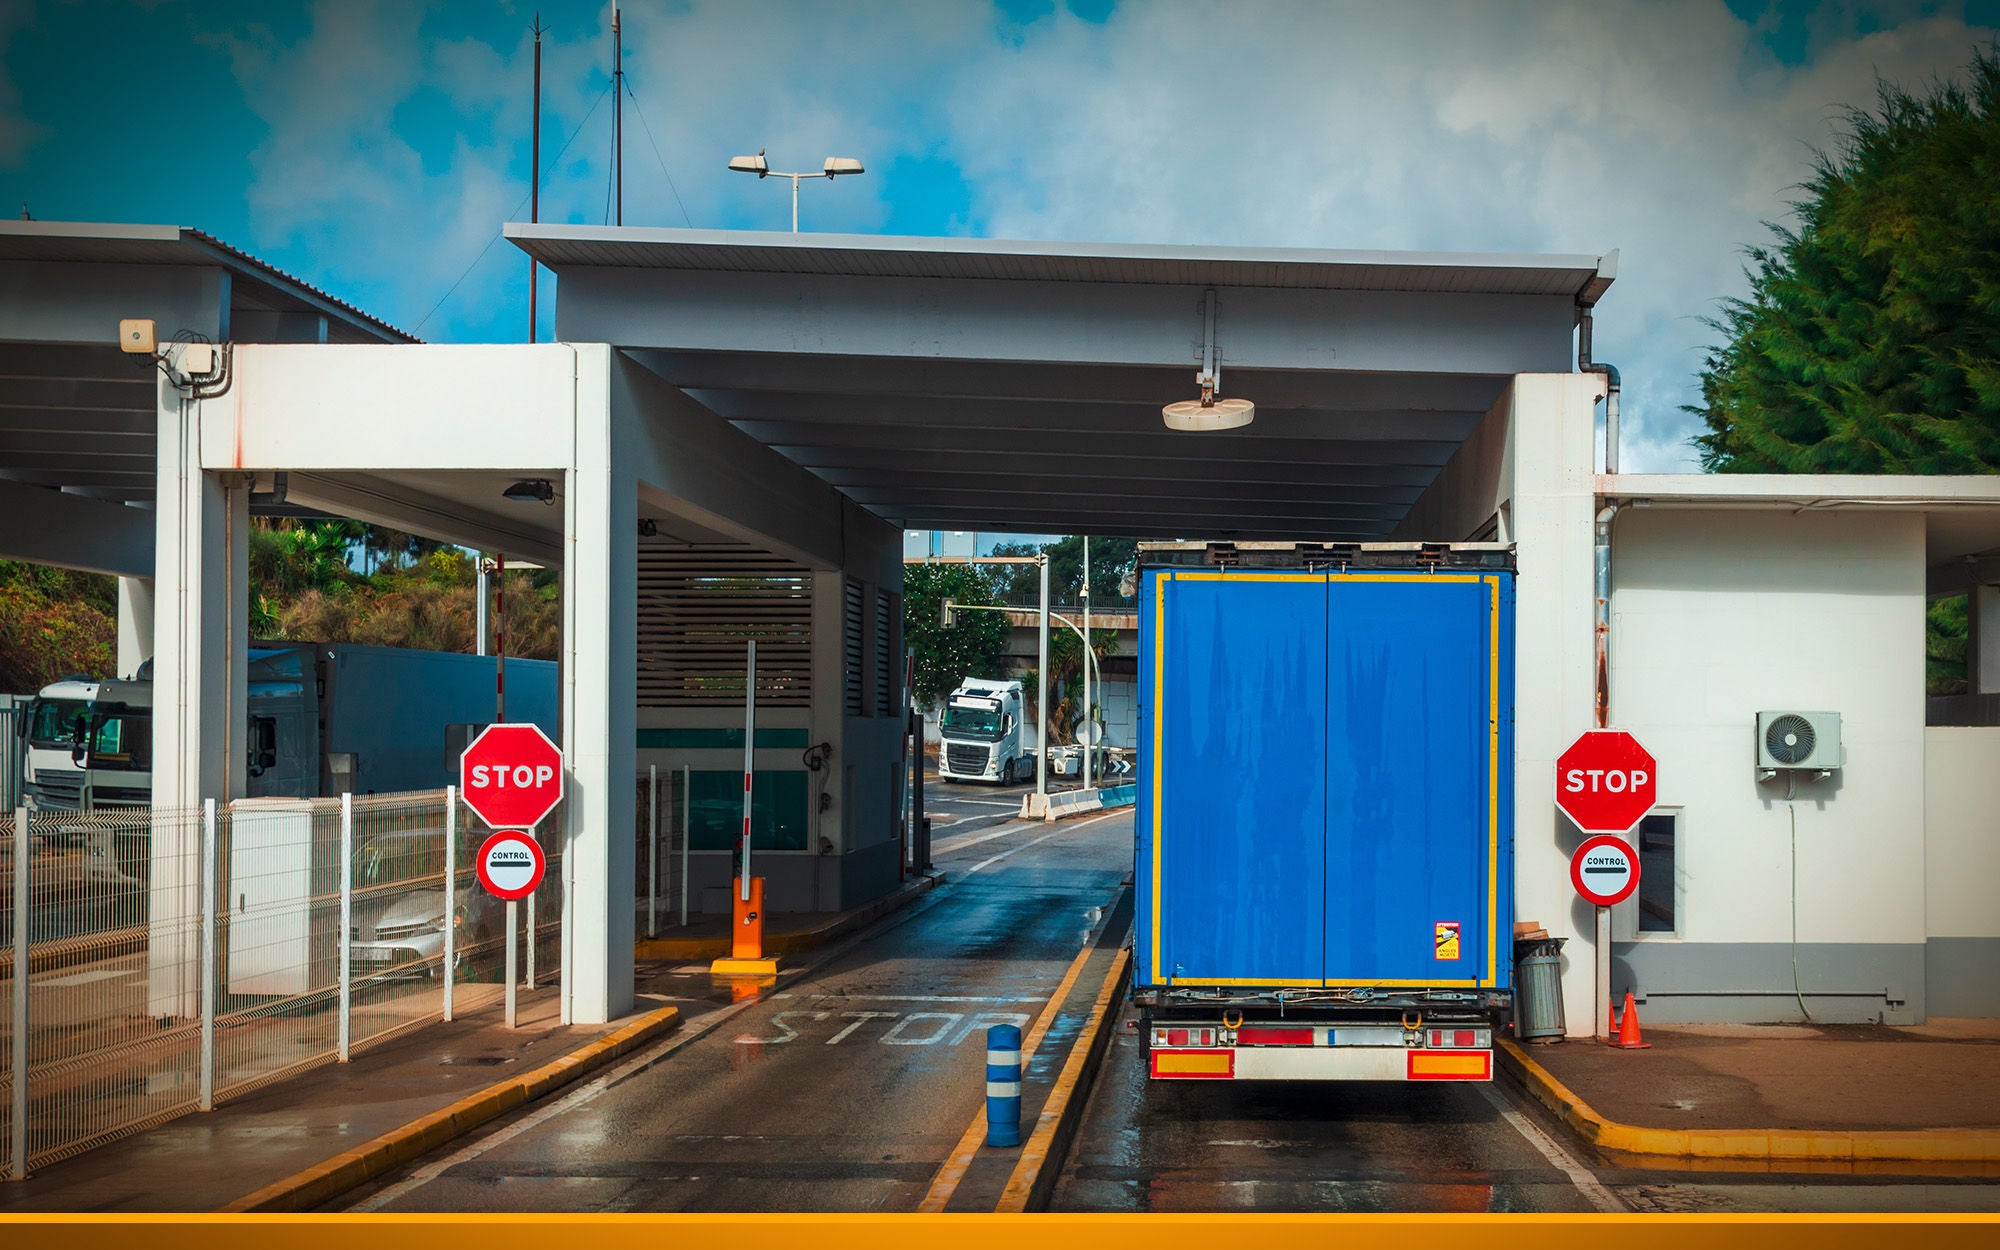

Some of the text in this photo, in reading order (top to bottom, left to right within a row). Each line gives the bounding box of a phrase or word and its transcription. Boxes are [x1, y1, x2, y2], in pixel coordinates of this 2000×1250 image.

[471, 765, 553, 788] STOP
[1565, 769, 1648, 793] STOP
[492, 851, 529, 859] CONTROL
[1587, 857, 1626, 866] CONTROL
[732, 1011, 1032, 1045] STOP
